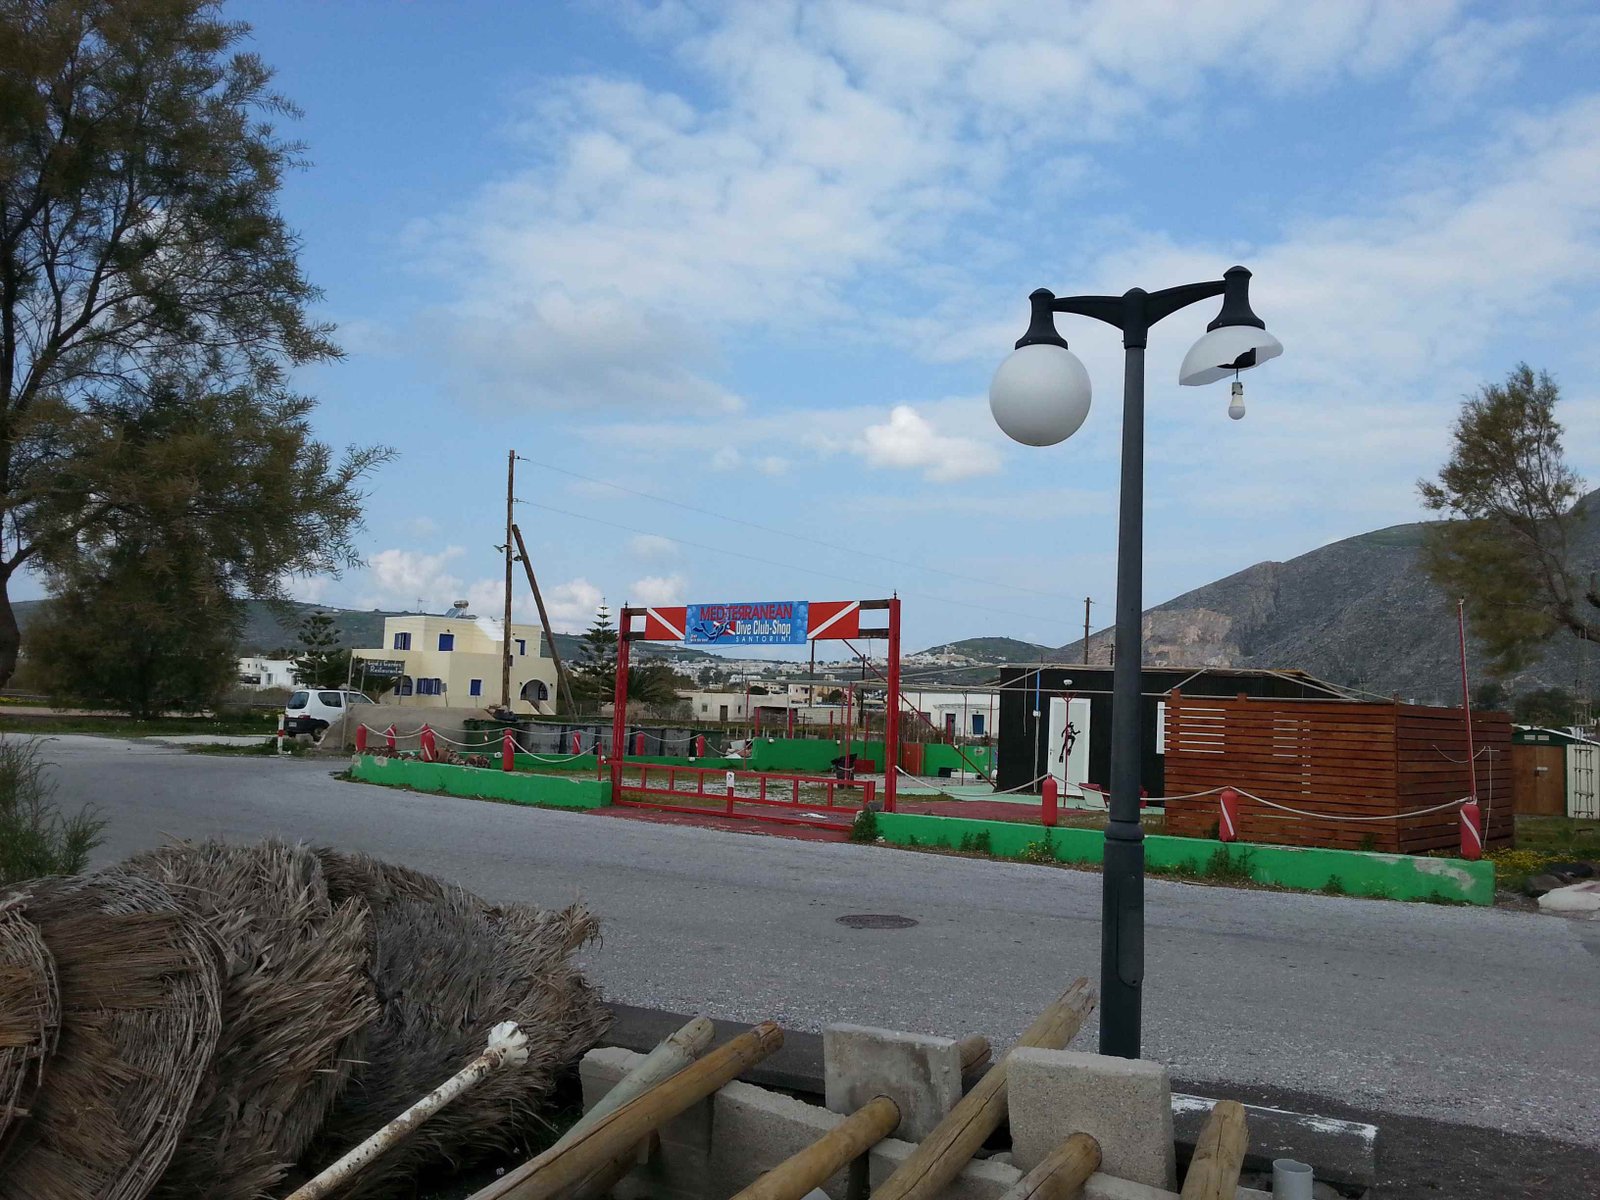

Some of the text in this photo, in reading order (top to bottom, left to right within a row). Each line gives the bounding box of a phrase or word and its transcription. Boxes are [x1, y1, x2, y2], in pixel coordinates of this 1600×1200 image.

[700, 603, 792, 621] MEDITERRANEAN
[736, 619, 791, 638] Dive Club-Shop
